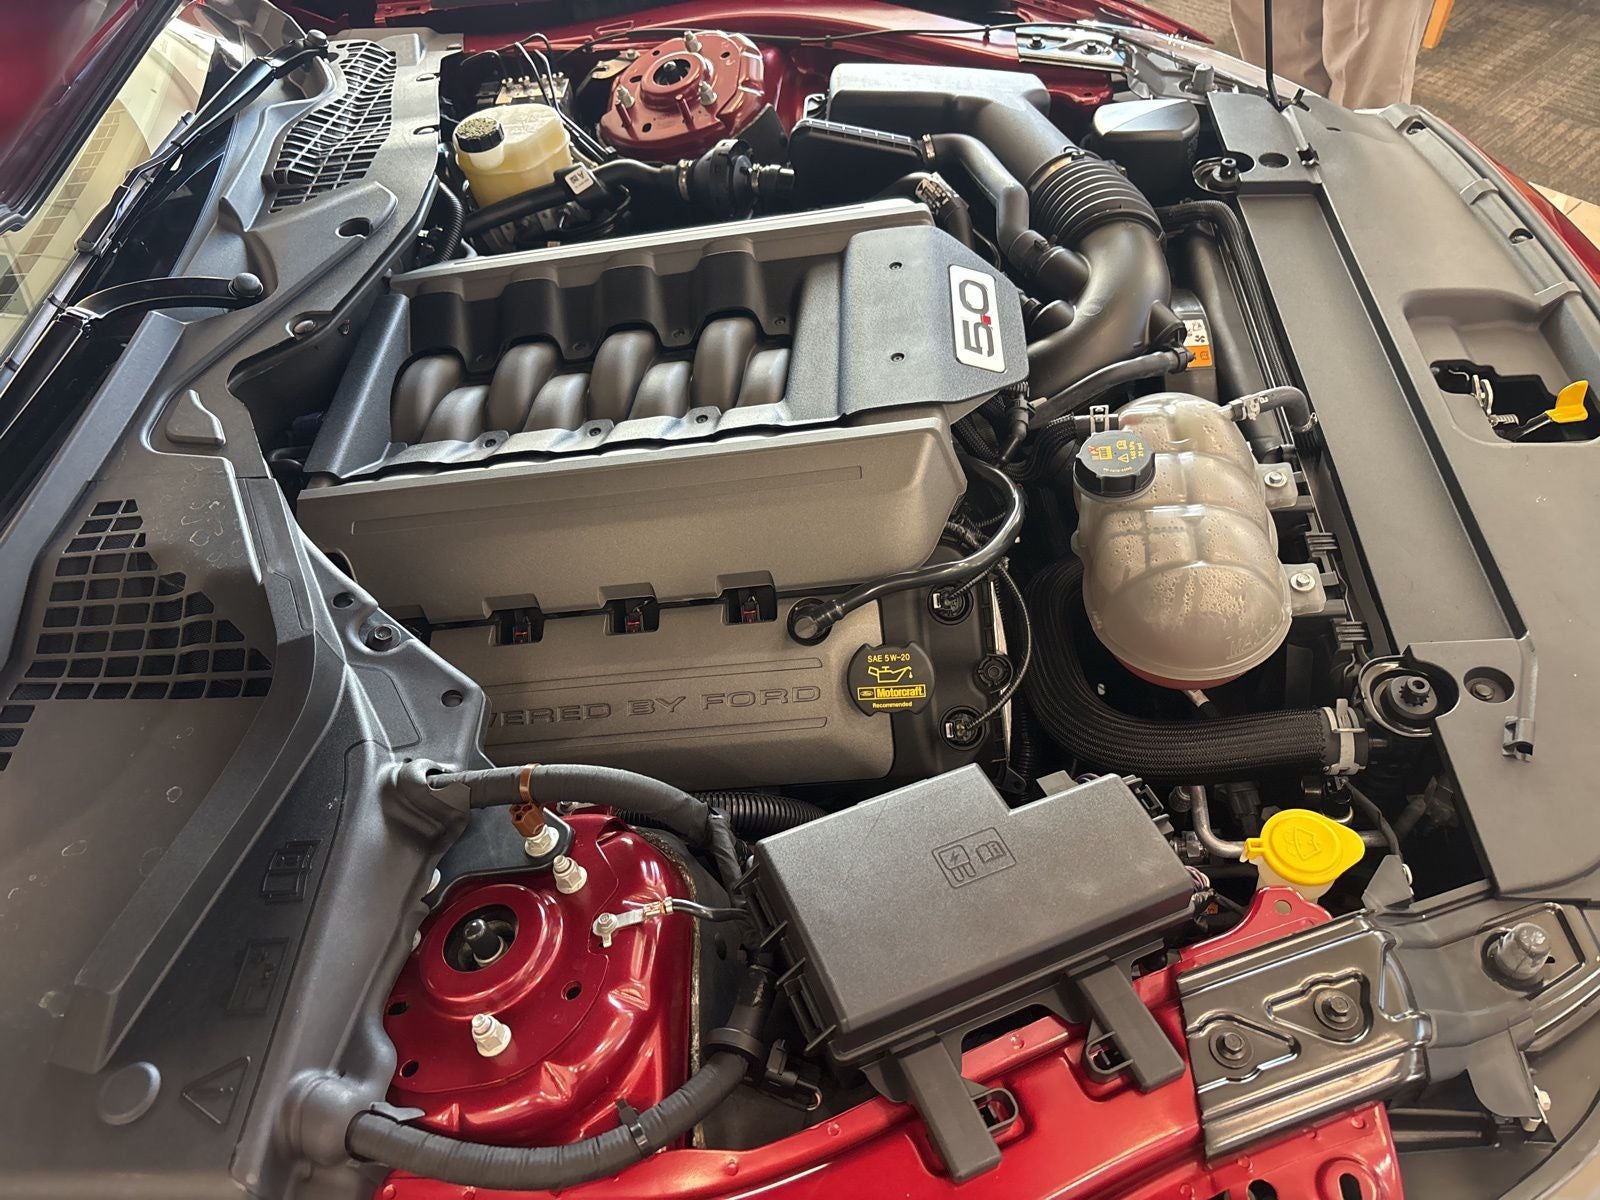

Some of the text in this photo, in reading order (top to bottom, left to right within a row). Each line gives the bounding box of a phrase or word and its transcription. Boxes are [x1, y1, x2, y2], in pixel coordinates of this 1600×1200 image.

[958, 279, 995, 358] 5.0
[868, 653, 910, 663] SAE 5W-20
[627, 695, 686, 716] BY
[702, 686, 821, 711] FORD
[876, 686, 923, 698] Motorcraft
